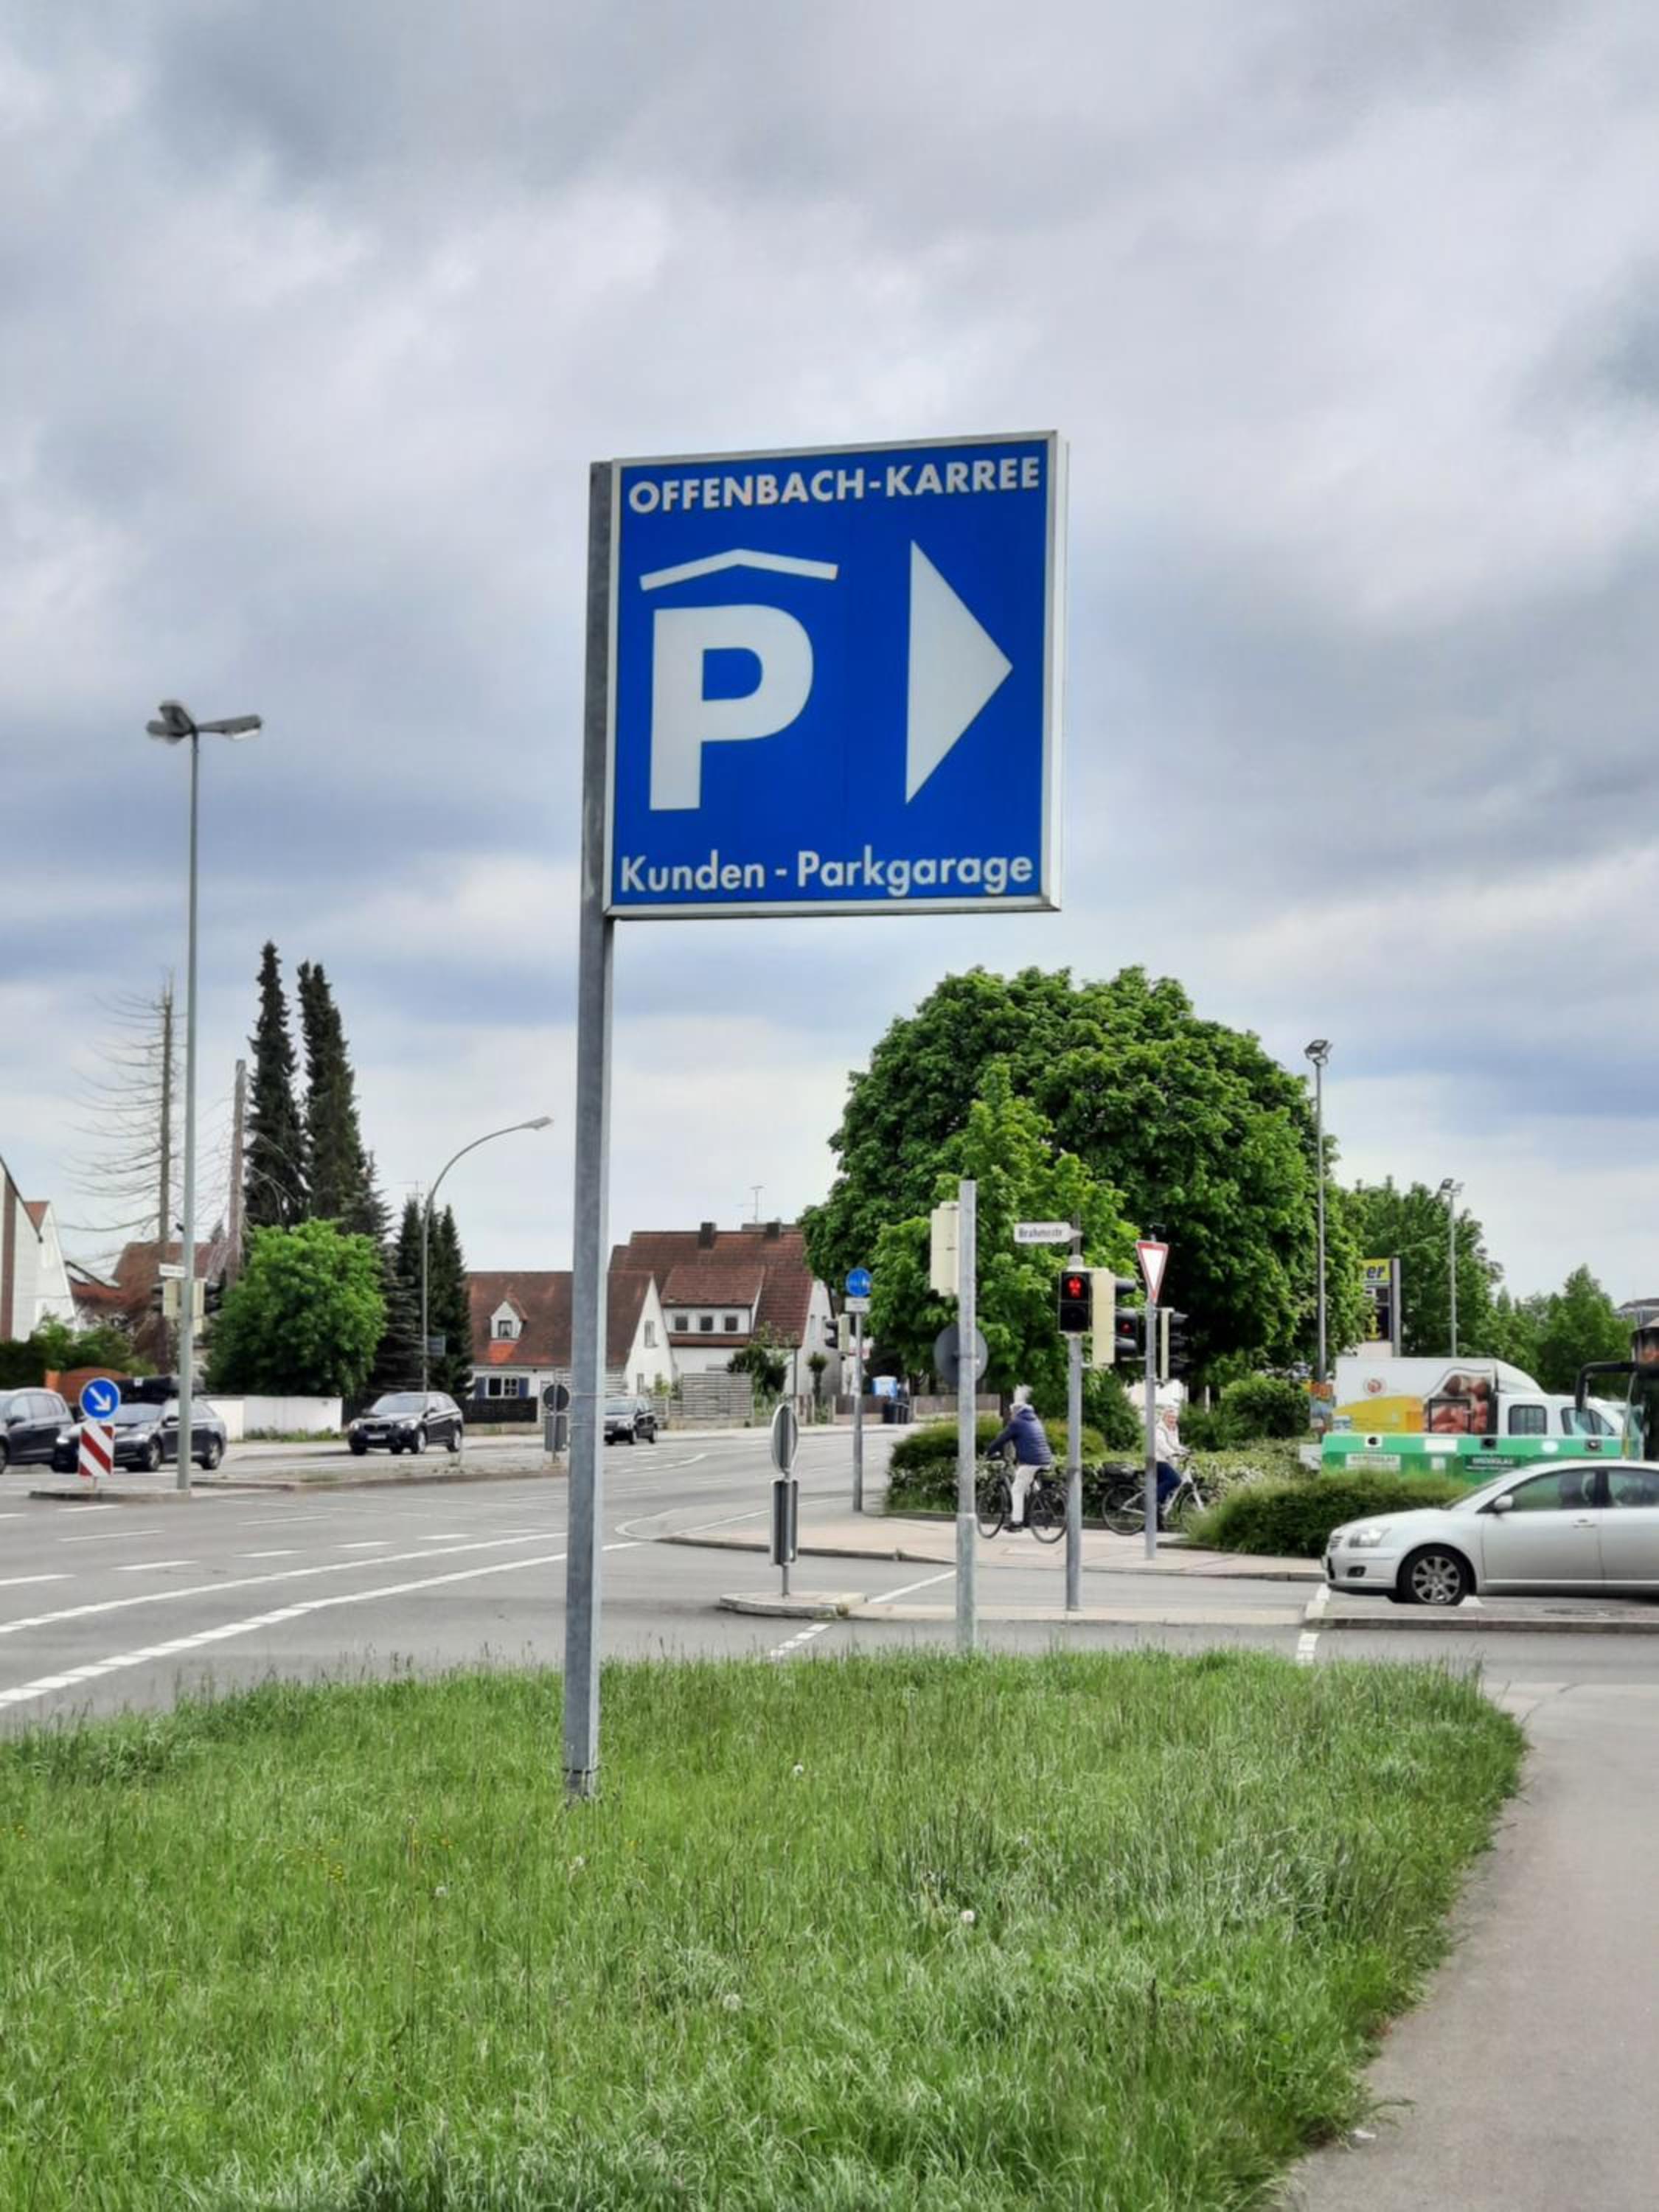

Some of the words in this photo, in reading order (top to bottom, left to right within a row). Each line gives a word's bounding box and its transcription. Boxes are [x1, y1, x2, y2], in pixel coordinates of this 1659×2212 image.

[629, 457, 1039, 513] OFFENBACH-KARREE
[650, 604, 814, 810] P
[621, 849, 765, 891] Kunden
[798, 845, 1032, 897] Parkgarage
